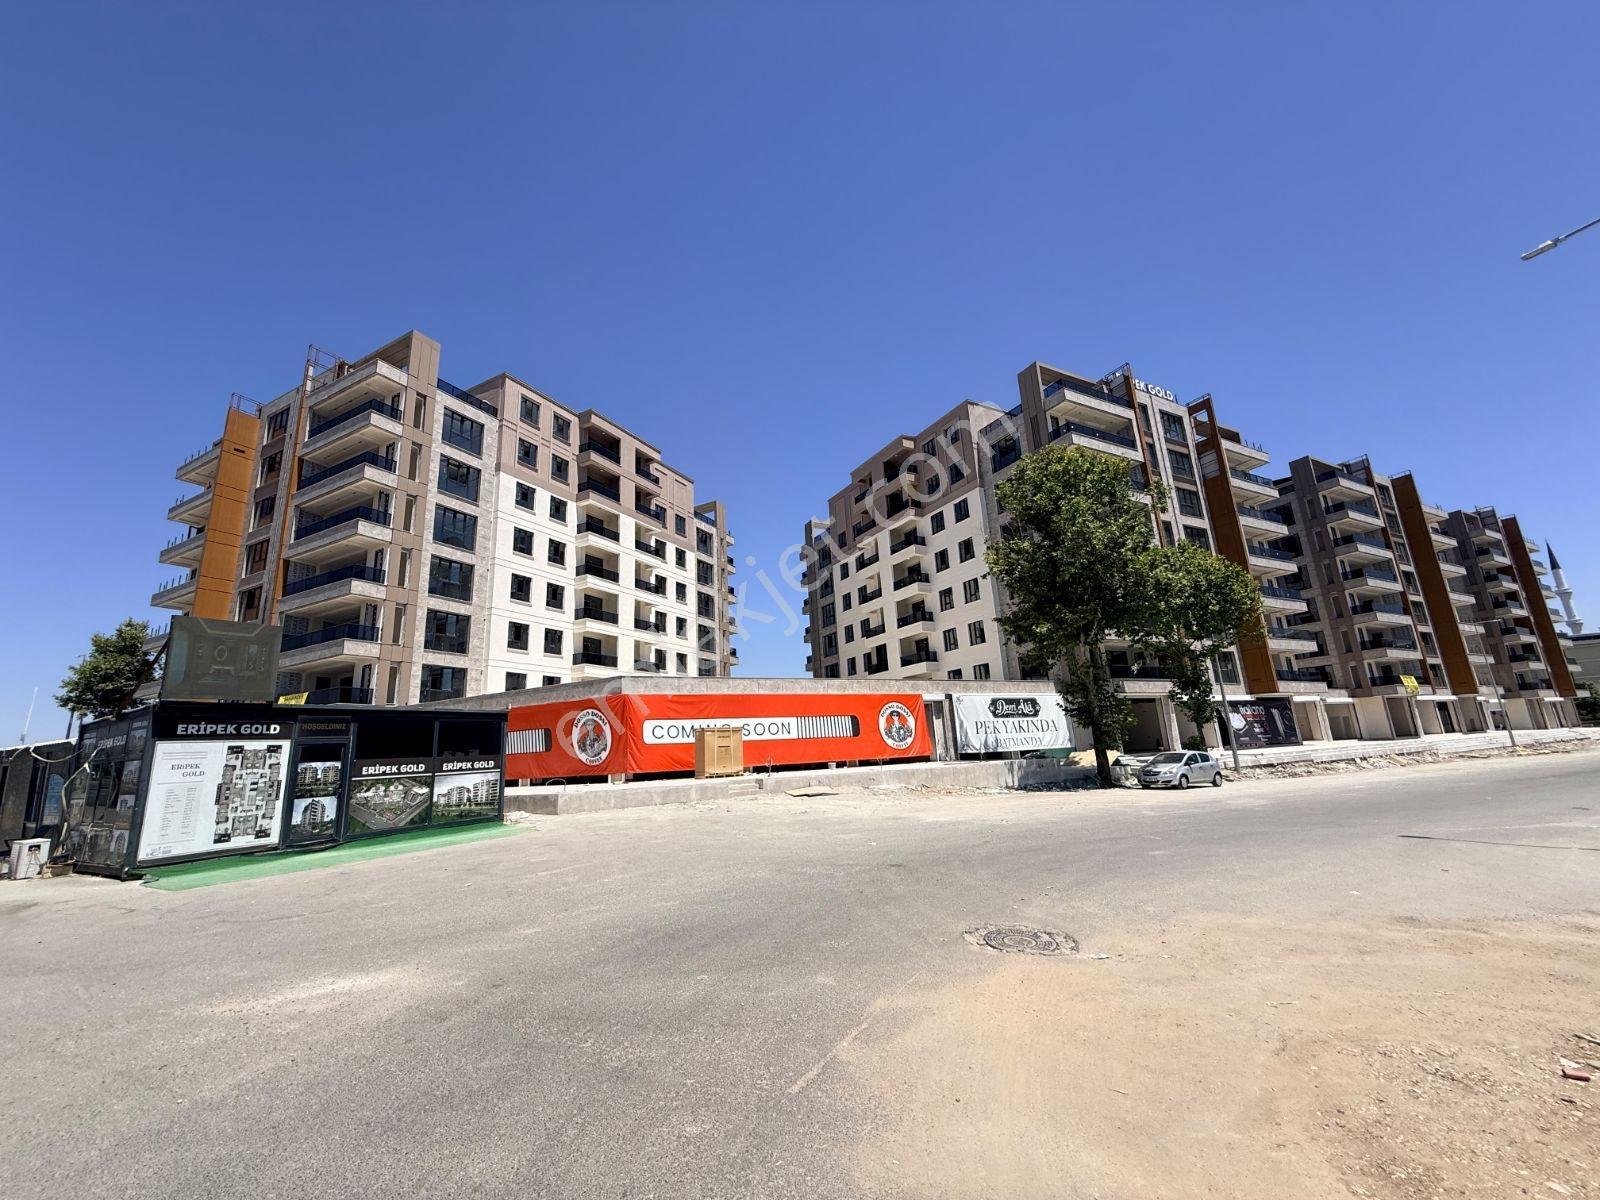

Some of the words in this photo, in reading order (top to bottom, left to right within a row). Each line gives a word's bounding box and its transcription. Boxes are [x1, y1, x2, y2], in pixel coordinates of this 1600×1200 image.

[1148, 384, 1174, 401] GOLD
[176, 721, 237, 735] ERİPEK
[240, 724, 281, 734] GOLD
[574, 711, 591, 729] DOSSO
[975, 720, 1001, 735] PEK
[1002, 719, 1059, 734] YAKINDA
[742, 721, 792, 737] SOON
[362, 764, 398, 775] ERİPEK
[400, 763, 426, 773] GOLD
[442, 760, 473, 771] ERİPEK
[474, 760, 495, 769] GOLD
